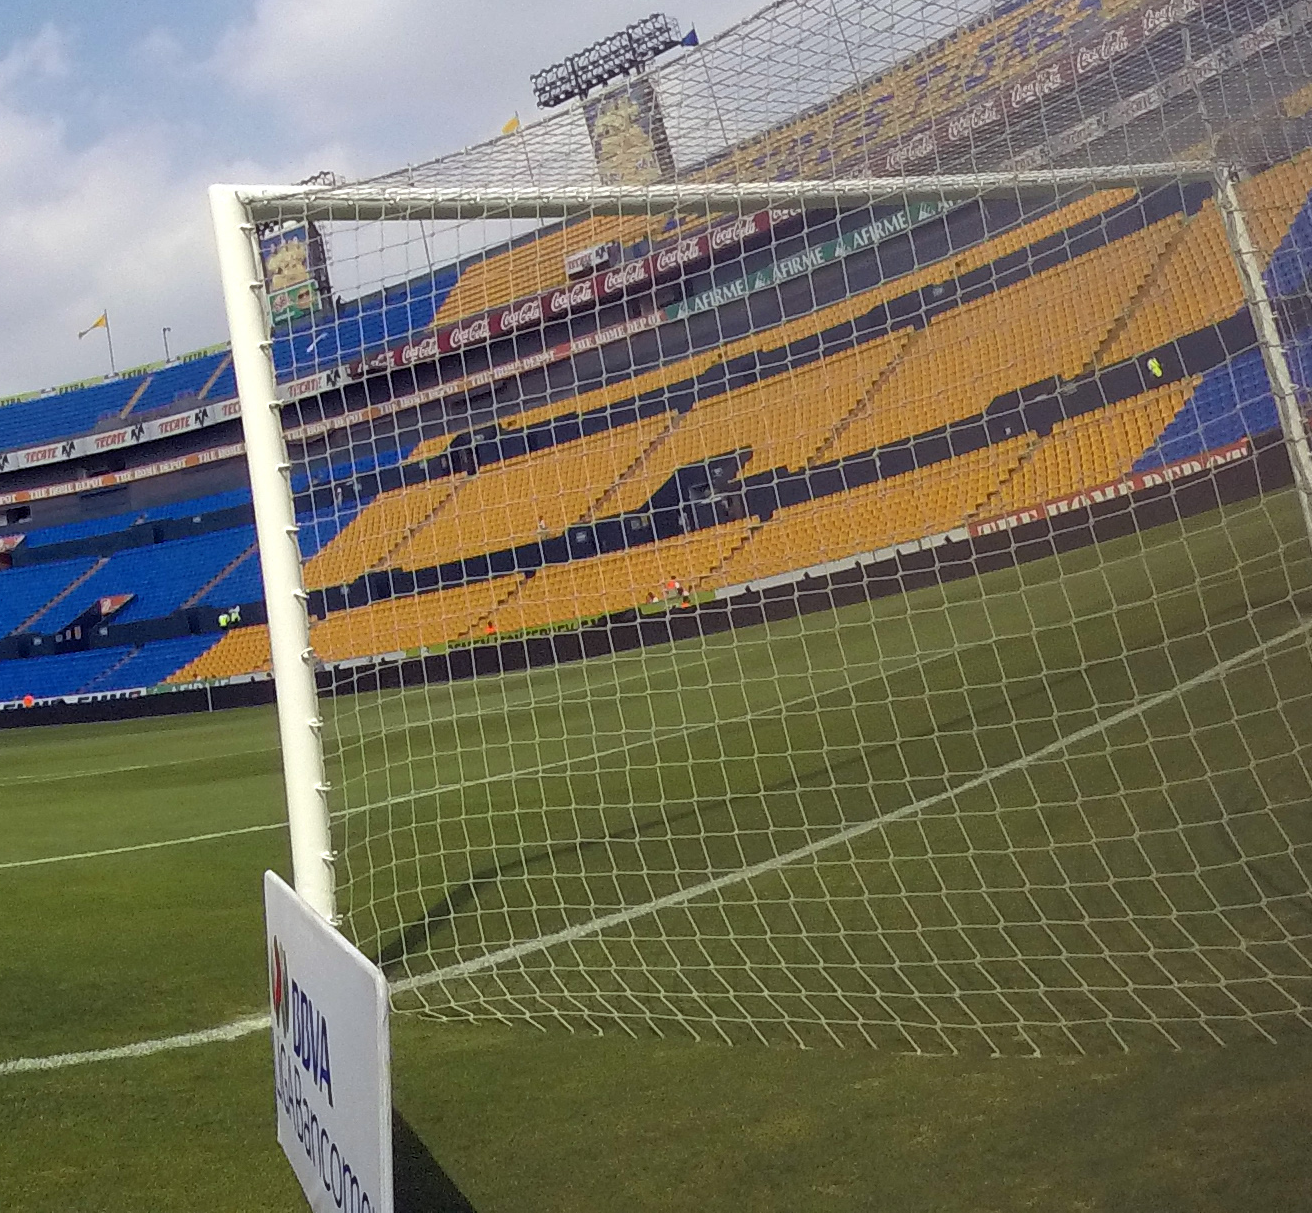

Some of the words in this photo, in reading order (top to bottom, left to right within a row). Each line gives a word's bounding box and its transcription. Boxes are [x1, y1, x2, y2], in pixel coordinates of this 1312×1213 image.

[854, 211, 908, 247] AFIRME
[773, 247, 824, 280] AFIRME
[694, 280, 744, 310] AFIRME
[94, 431, 129, 449] TECATE
[158, 416, 192, 434] TECATE
[24, 447, 59, 463] TECATE
[291, 978, 334, 1108] BBVA
